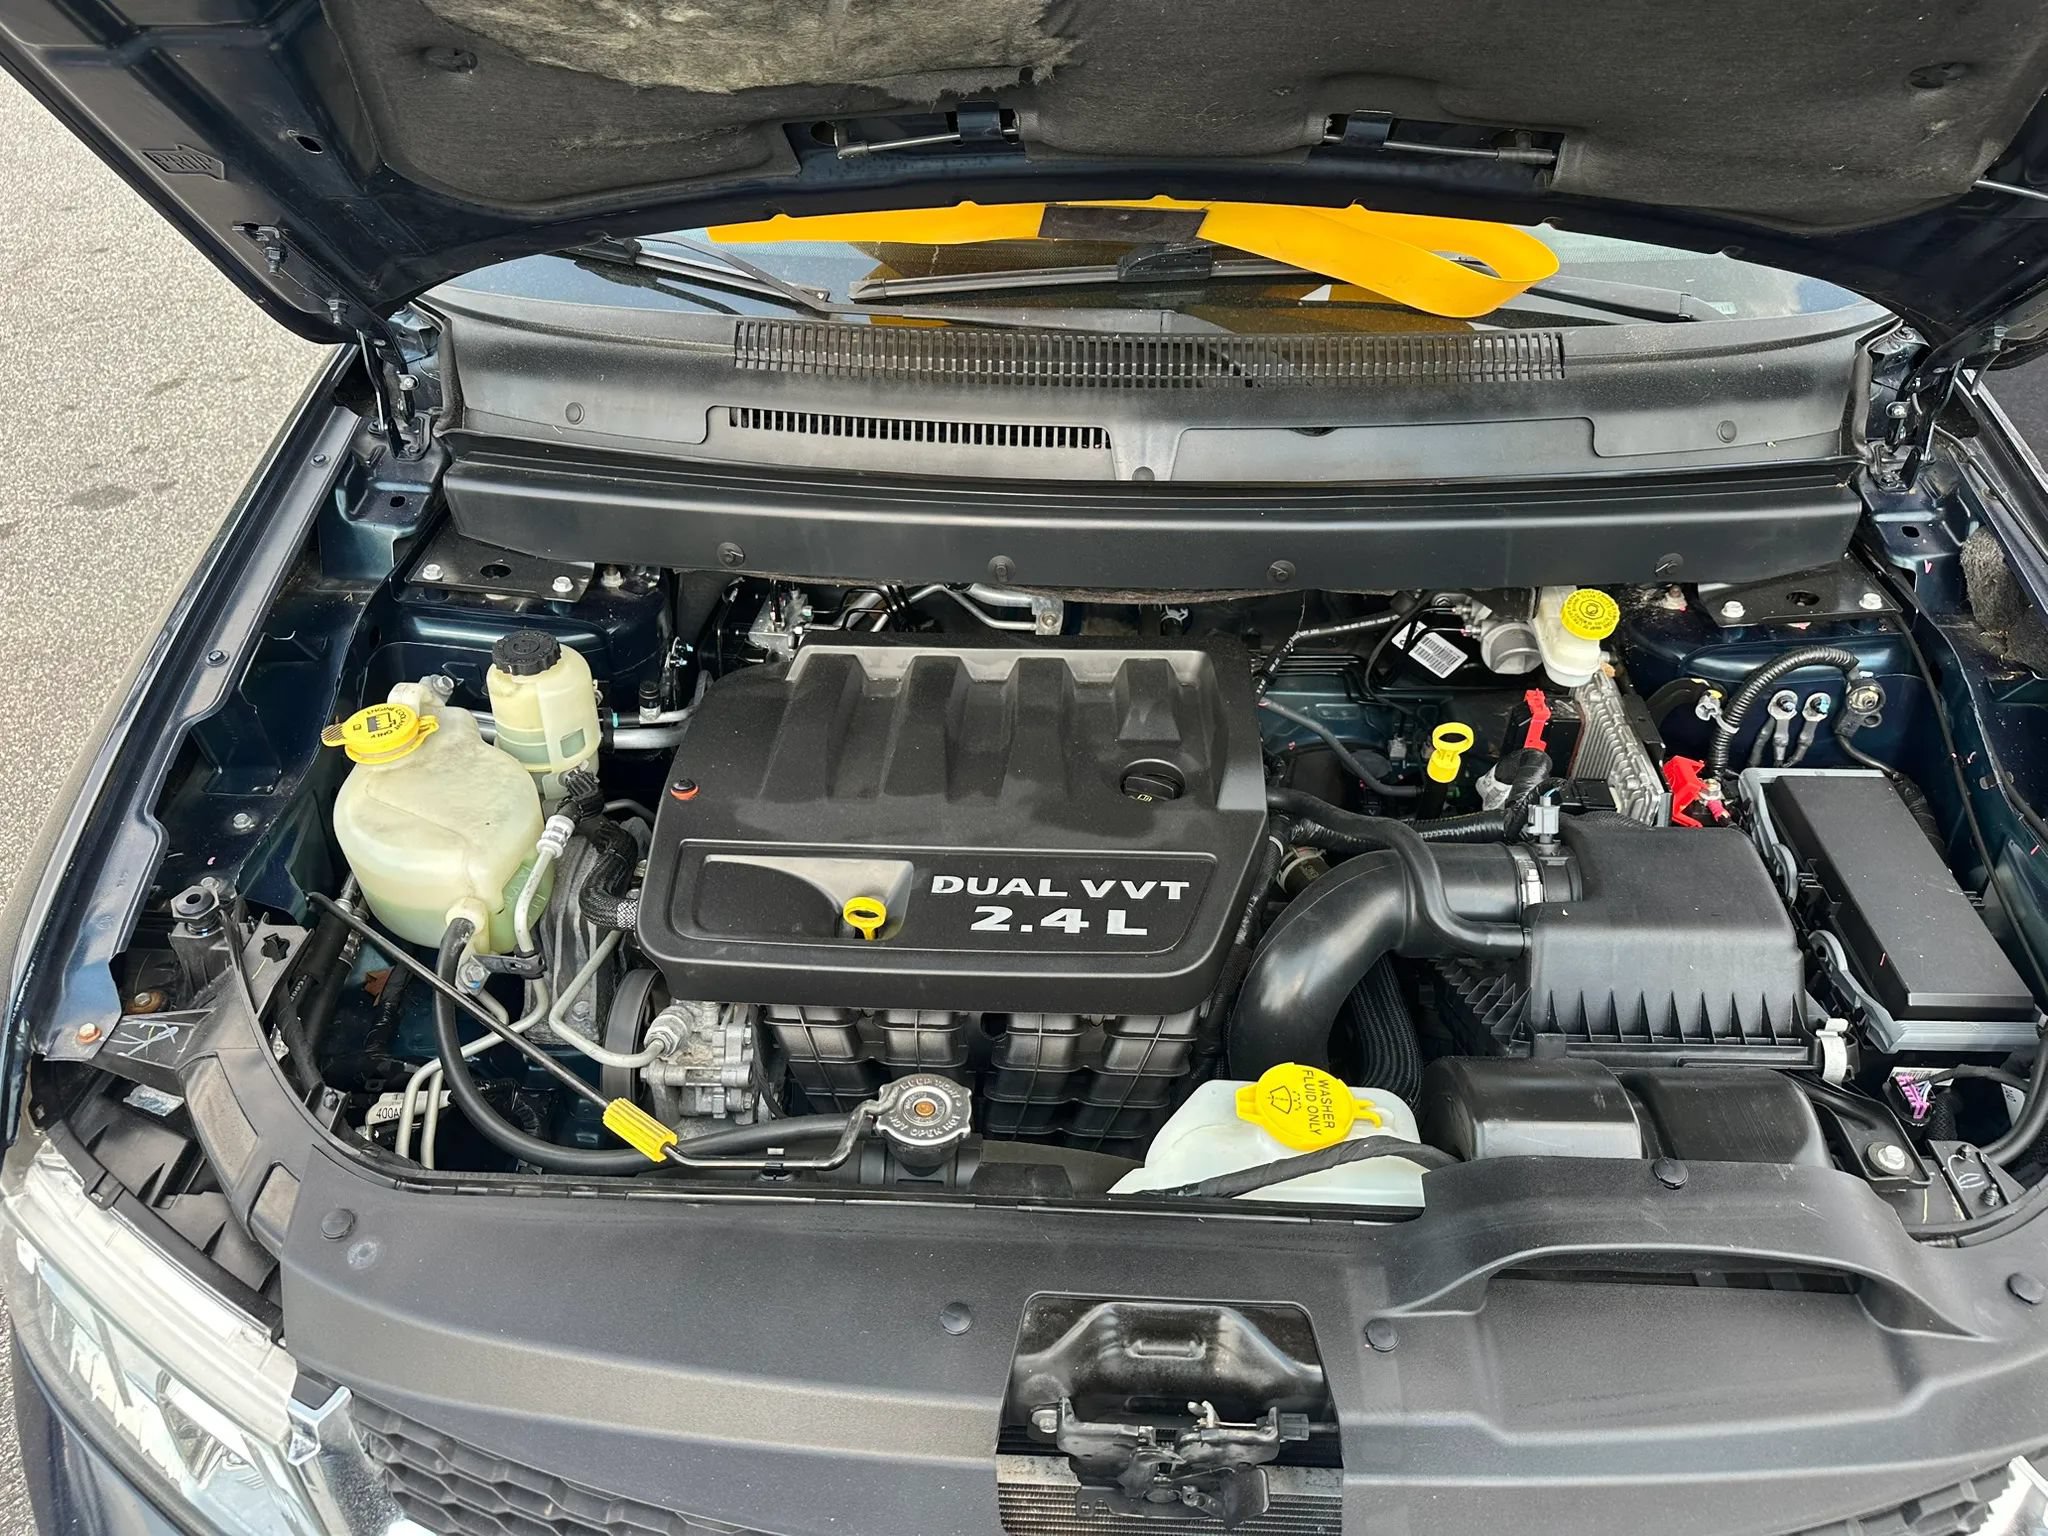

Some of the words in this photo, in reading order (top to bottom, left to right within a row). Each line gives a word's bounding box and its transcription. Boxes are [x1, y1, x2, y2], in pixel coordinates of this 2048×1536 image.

[931, 875, 1069, 898] DUAL
[1080, 879, 1190, 900] VVT
[970, 905, 1090, 934] 2.4
[1106, 909, 1148, 936] L
[1302, 1069, 1318, 1103] FLUID
[376, 1107, 402, 1119] 400A
[1318, 1079, 1336, 1129] WASHER
[1306, 1105, 1322, 1136] ONLY
